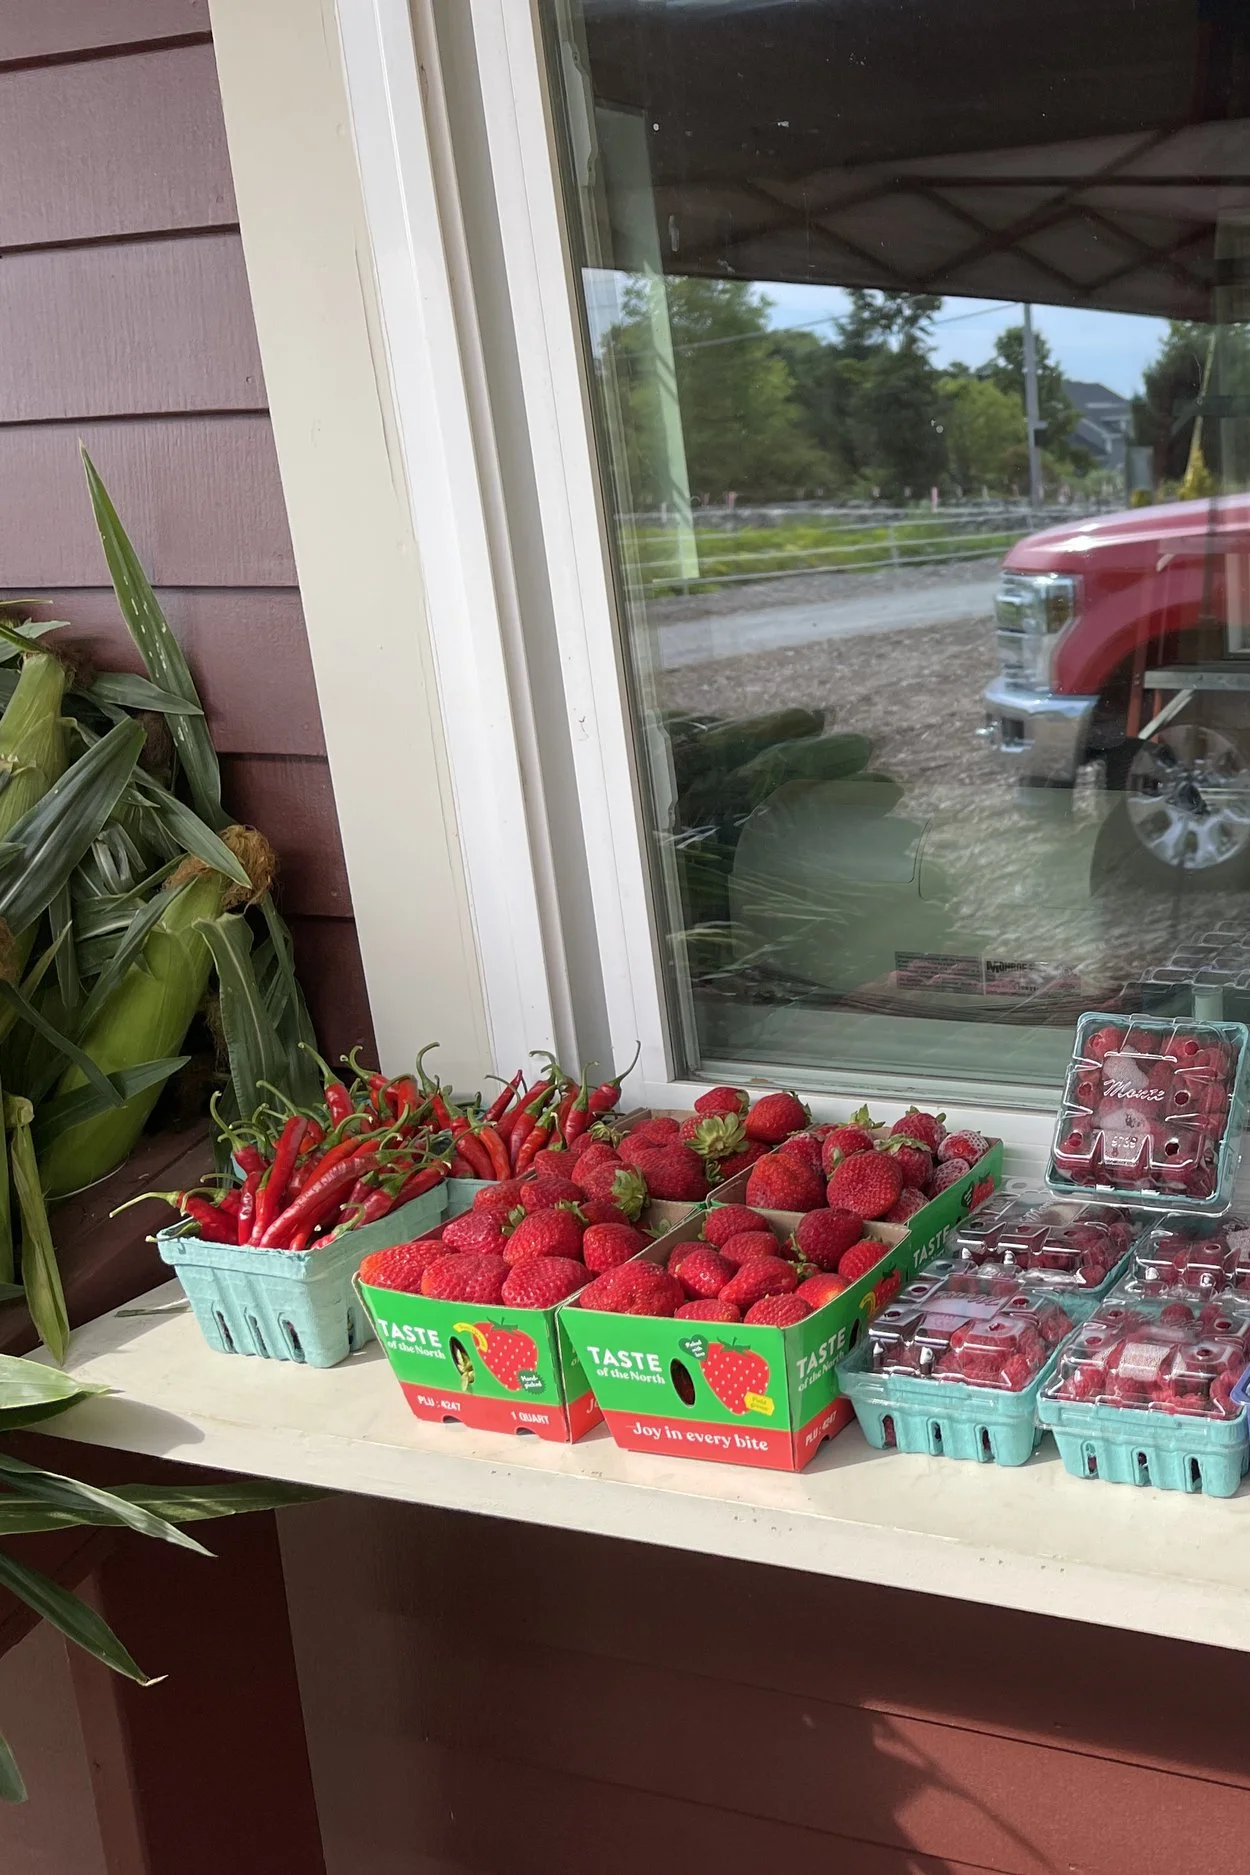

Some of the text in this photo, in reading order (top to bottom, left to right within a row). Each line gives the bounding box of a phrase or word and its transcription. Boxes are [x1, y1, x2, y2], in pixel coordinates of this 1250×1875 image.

[913, 1224, 950, 1269] TASTE
[377, 1319, 442, 1348] TASTE
[387, 1340, 446, 1360] of the North
[586, 1346, 663, 1372] TASTE
[796, 1326, 846, 1379] TASTE
[596, 1366, 666, 1384] of the North
[417, 1394, 435, 1408] PLU
[440, 1400, 461, 1411] 4247
[511, 1410, 550, 1425] 1 QUART
[633, 1421, 769, 1451] Joy in every bite
